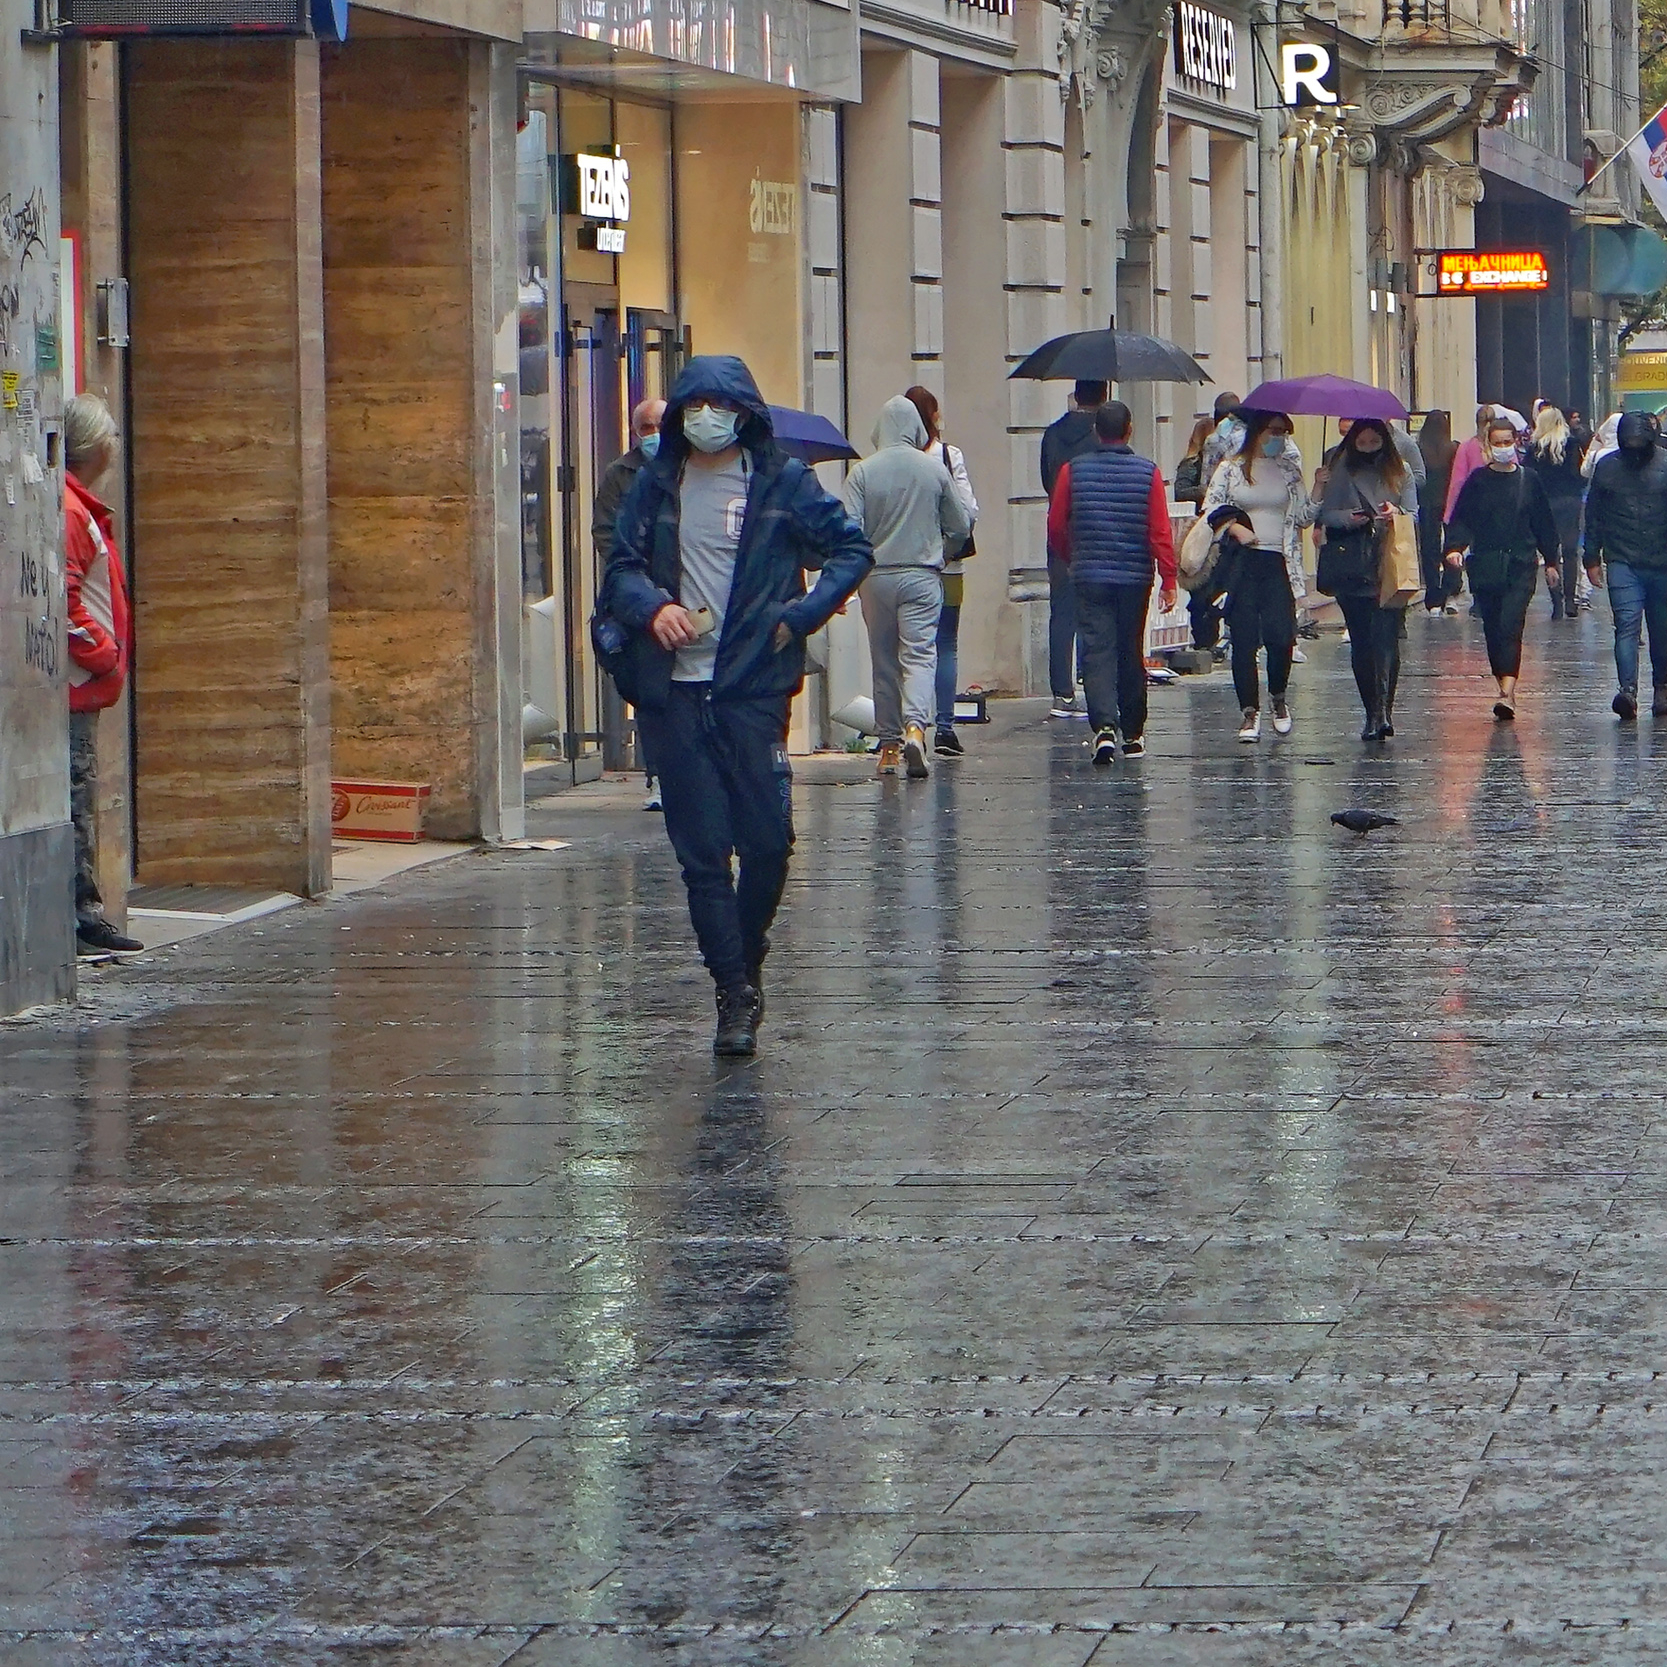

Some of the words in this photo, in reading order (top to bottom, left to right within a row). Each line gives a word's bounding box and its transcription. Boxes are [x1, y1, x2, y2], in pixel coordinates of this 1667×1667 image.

[1181, 1, 1236, 90] RESERVED
[1283, 43, 1338, 105] R
[1442, 254, 1543, 271] МЕЊАЧНИЦА
